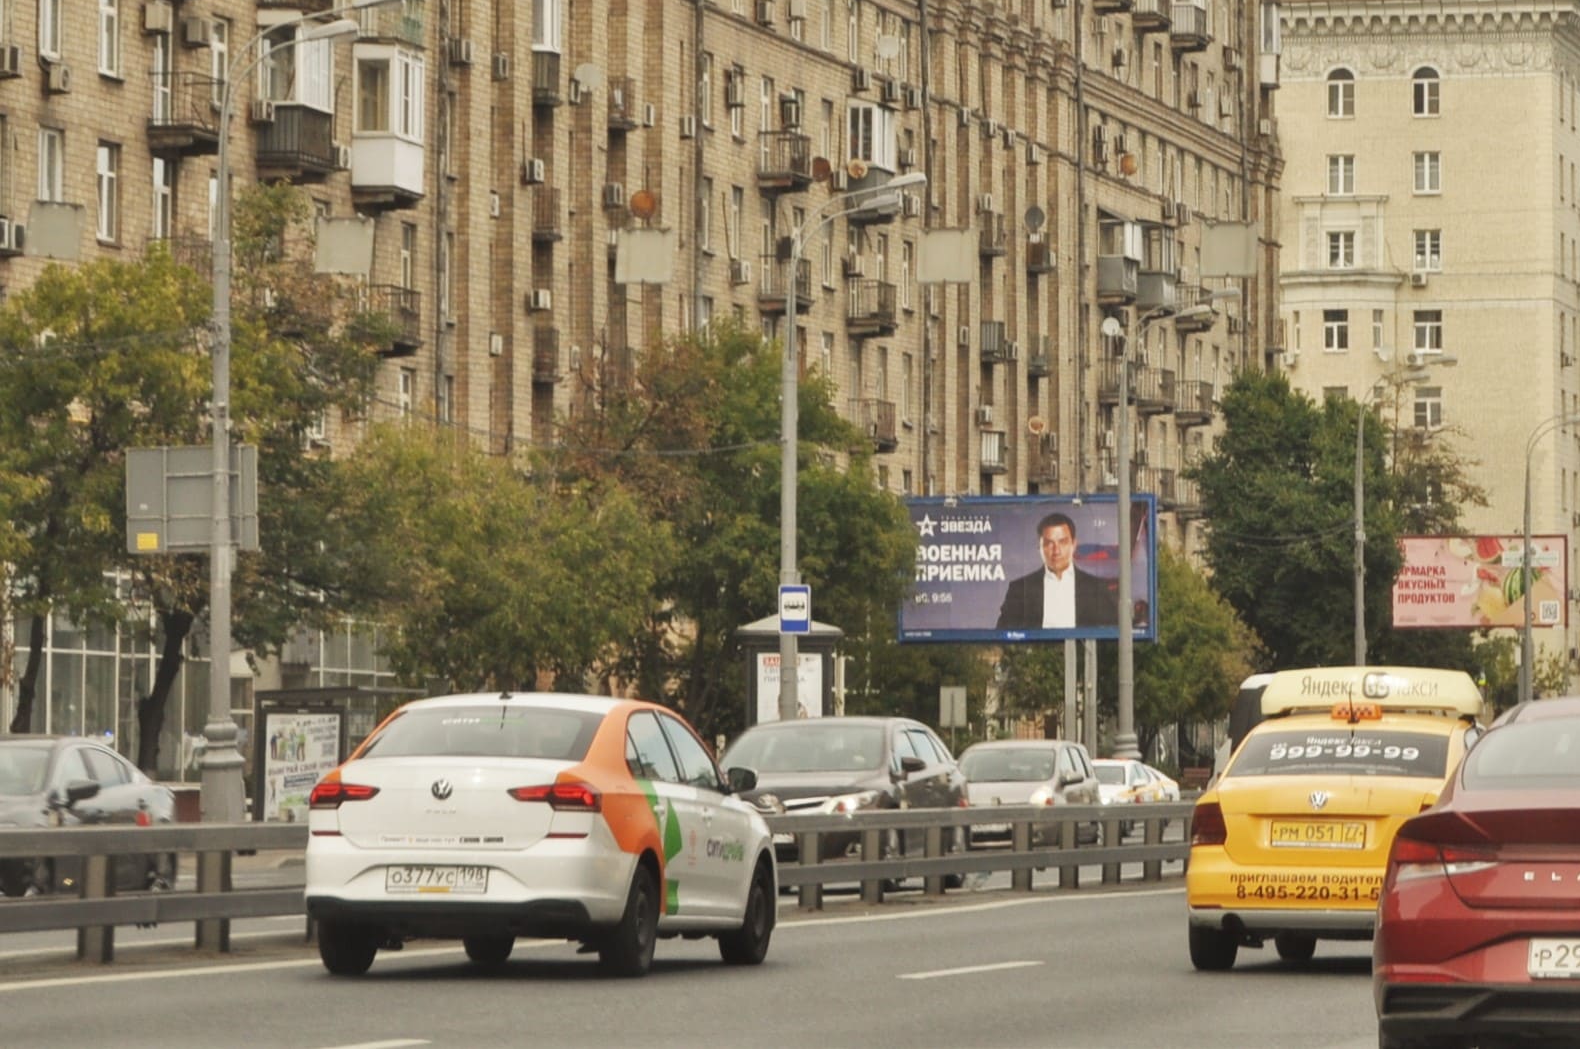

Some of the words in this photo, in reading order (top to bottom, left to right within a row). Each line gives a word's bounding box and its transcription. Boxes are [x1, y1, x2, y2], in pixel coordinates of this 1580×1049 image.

[940, 519, 992, 534] ЗВЕЗДА
[914, 543, 1003, 562] ВОЕННАЯ
[914, 564, 1006, 582] ПРИЕМКА
[1398, 579, 1446, 590] ВКУСНЫХ
[1398, 593, 1456, 604] ПРОДУКТОВ
[1300, 676, 1358, 697] Яндекс
[1269, 746, 1420, 761] 999-99-99
[1279, 828, 1300, 839] РМ
[1305, 825, 1335, 839] 051
[391, 866, 455, 884] О377УС
[1230, 873, 1318, 885] приглашаем
[1322, 874, 1384, 886] водител
[1236, 885, 1380, 901] 8-495-220-31-5
